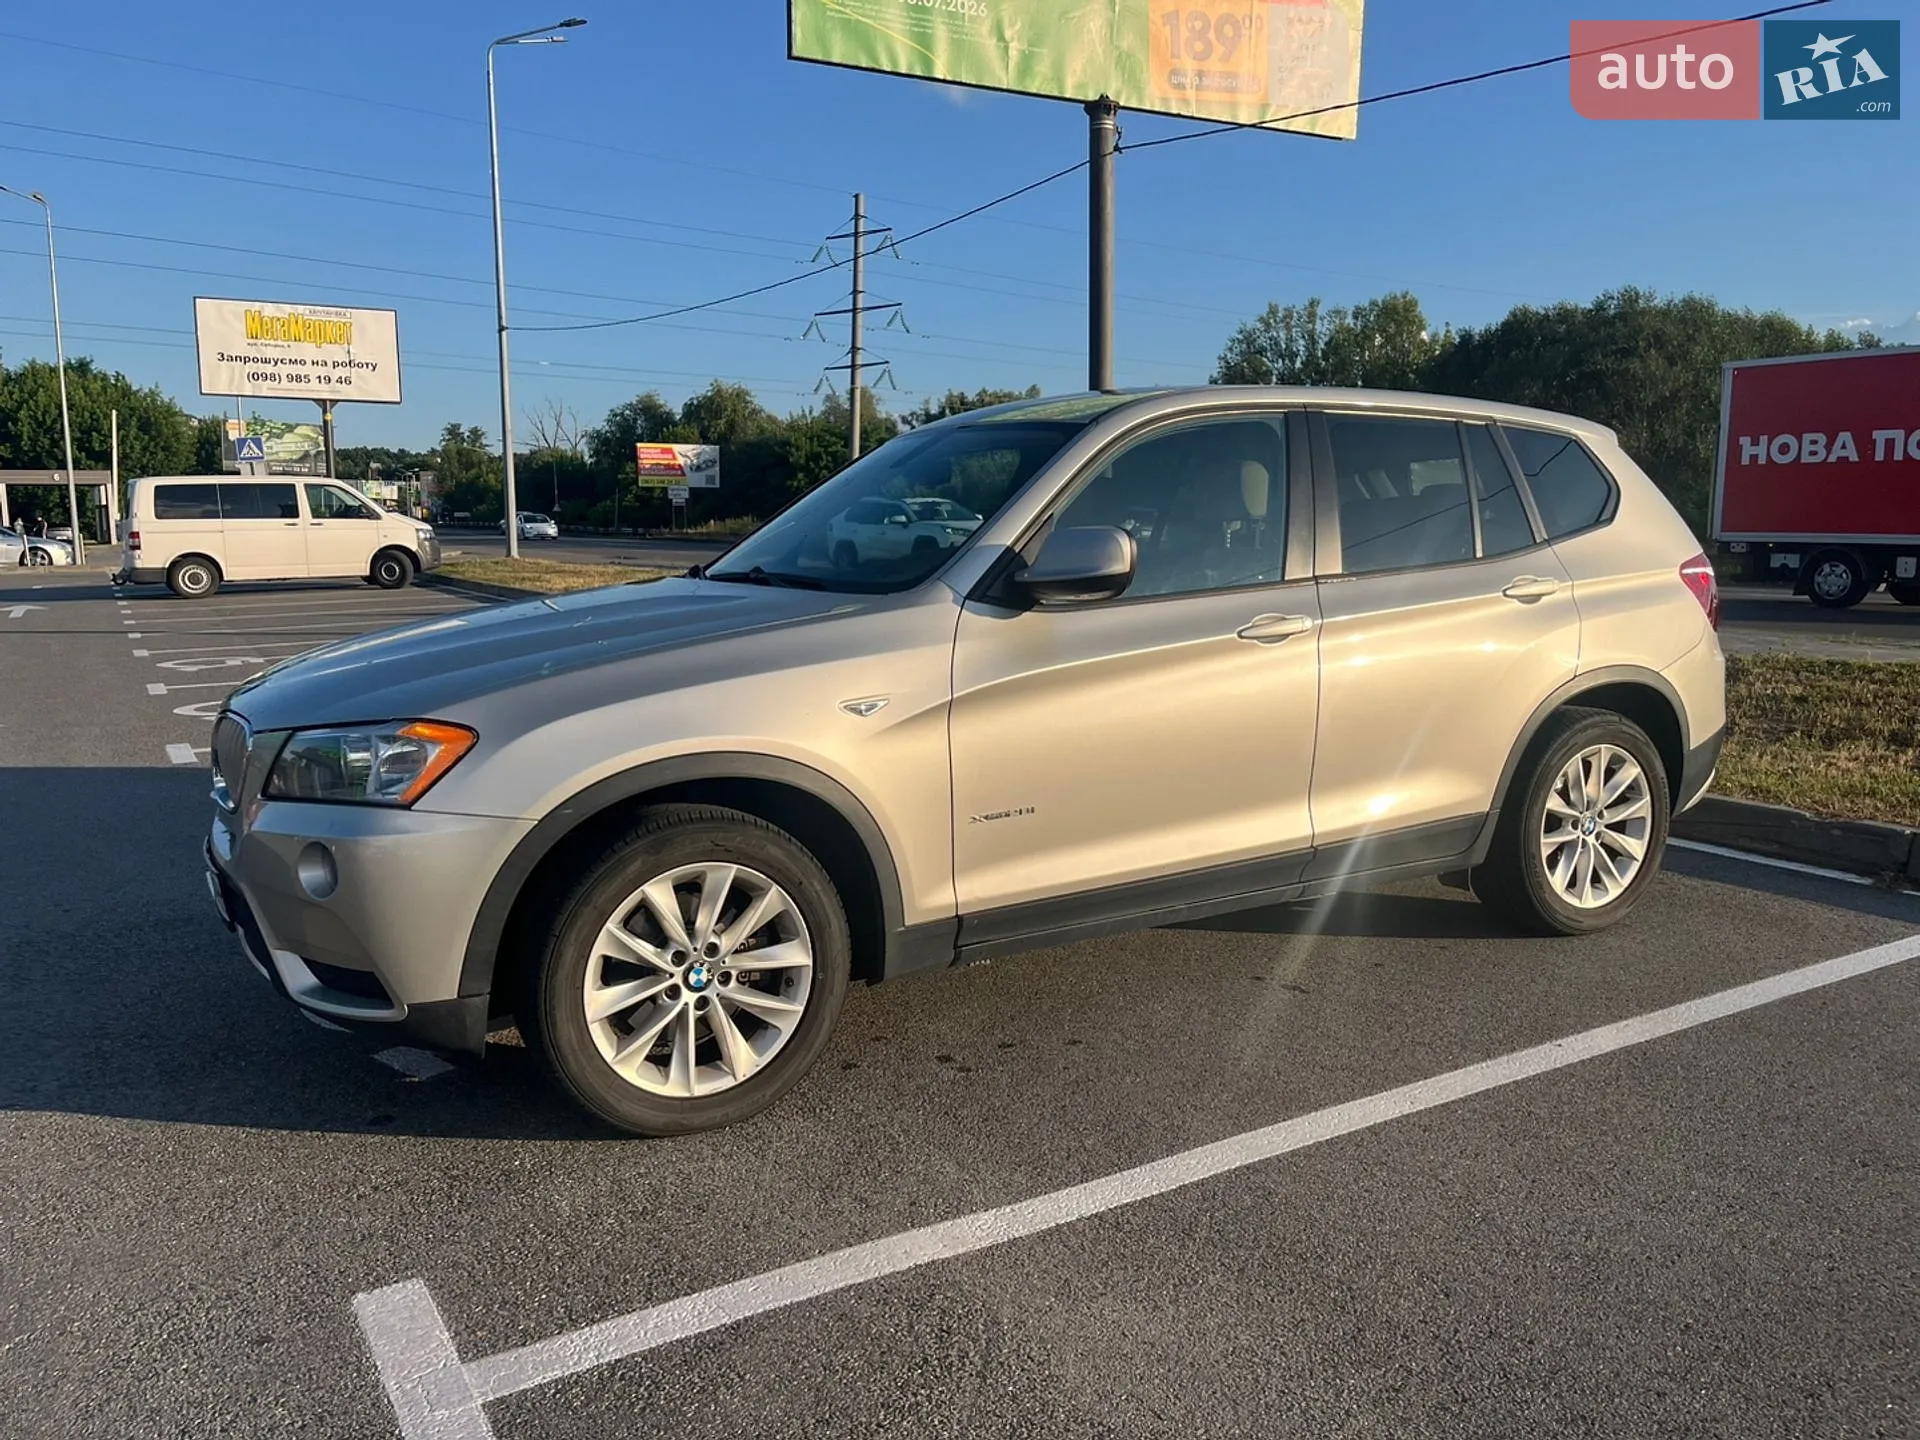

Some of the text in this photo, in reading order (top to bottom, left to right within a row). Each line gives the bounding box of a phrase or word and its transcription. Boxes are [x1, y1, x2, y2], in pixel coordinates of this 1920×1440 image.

[1163, 9, 1243, 63] 189
[244, 309, 352, 348] МегаМаркет
[247, 371, 352, 385] (098) 985 19 46
[311, 359, 328, 367] на
[332, 359, 378, 372] роботу
[1739, 431, 1859, 465] НОВА
